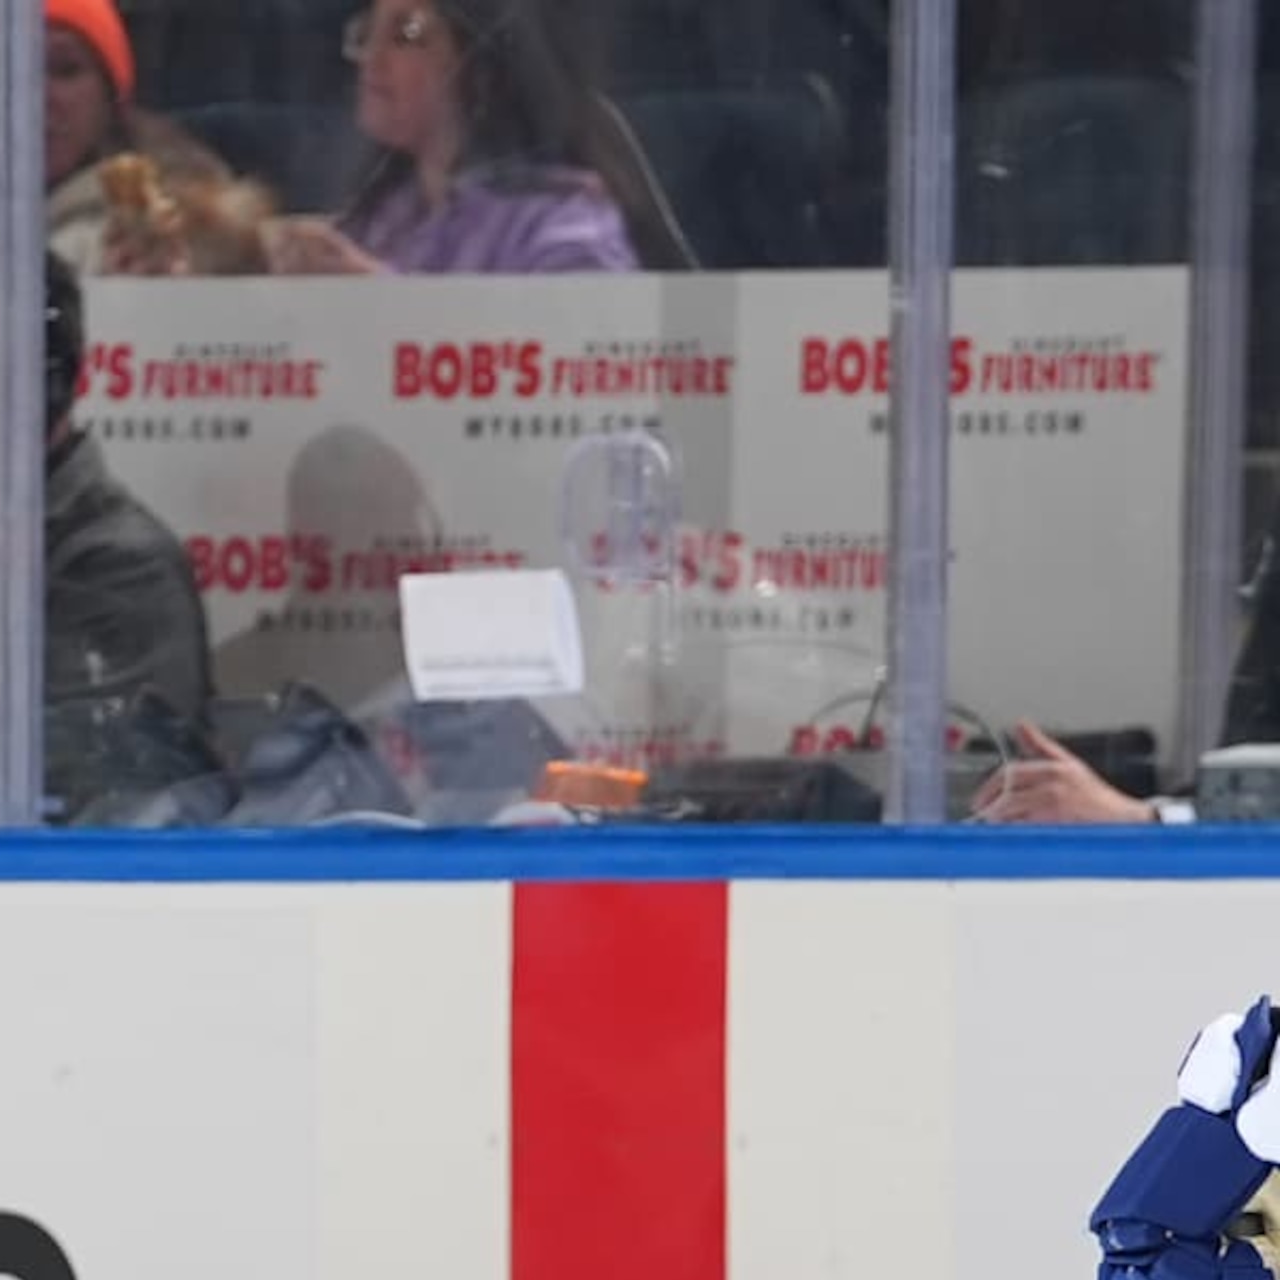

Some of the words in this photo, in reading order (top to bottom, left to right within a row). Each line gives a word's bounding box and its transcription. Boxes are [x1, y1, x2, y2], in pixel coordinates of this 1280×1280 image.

[142, 358, 320, 399] FURNITURE
[394, 341, 543, 399] BOB'S
[552, 355, 730, 395] FURNITURE
[982, 352, 1154, 392] FURNITURE
